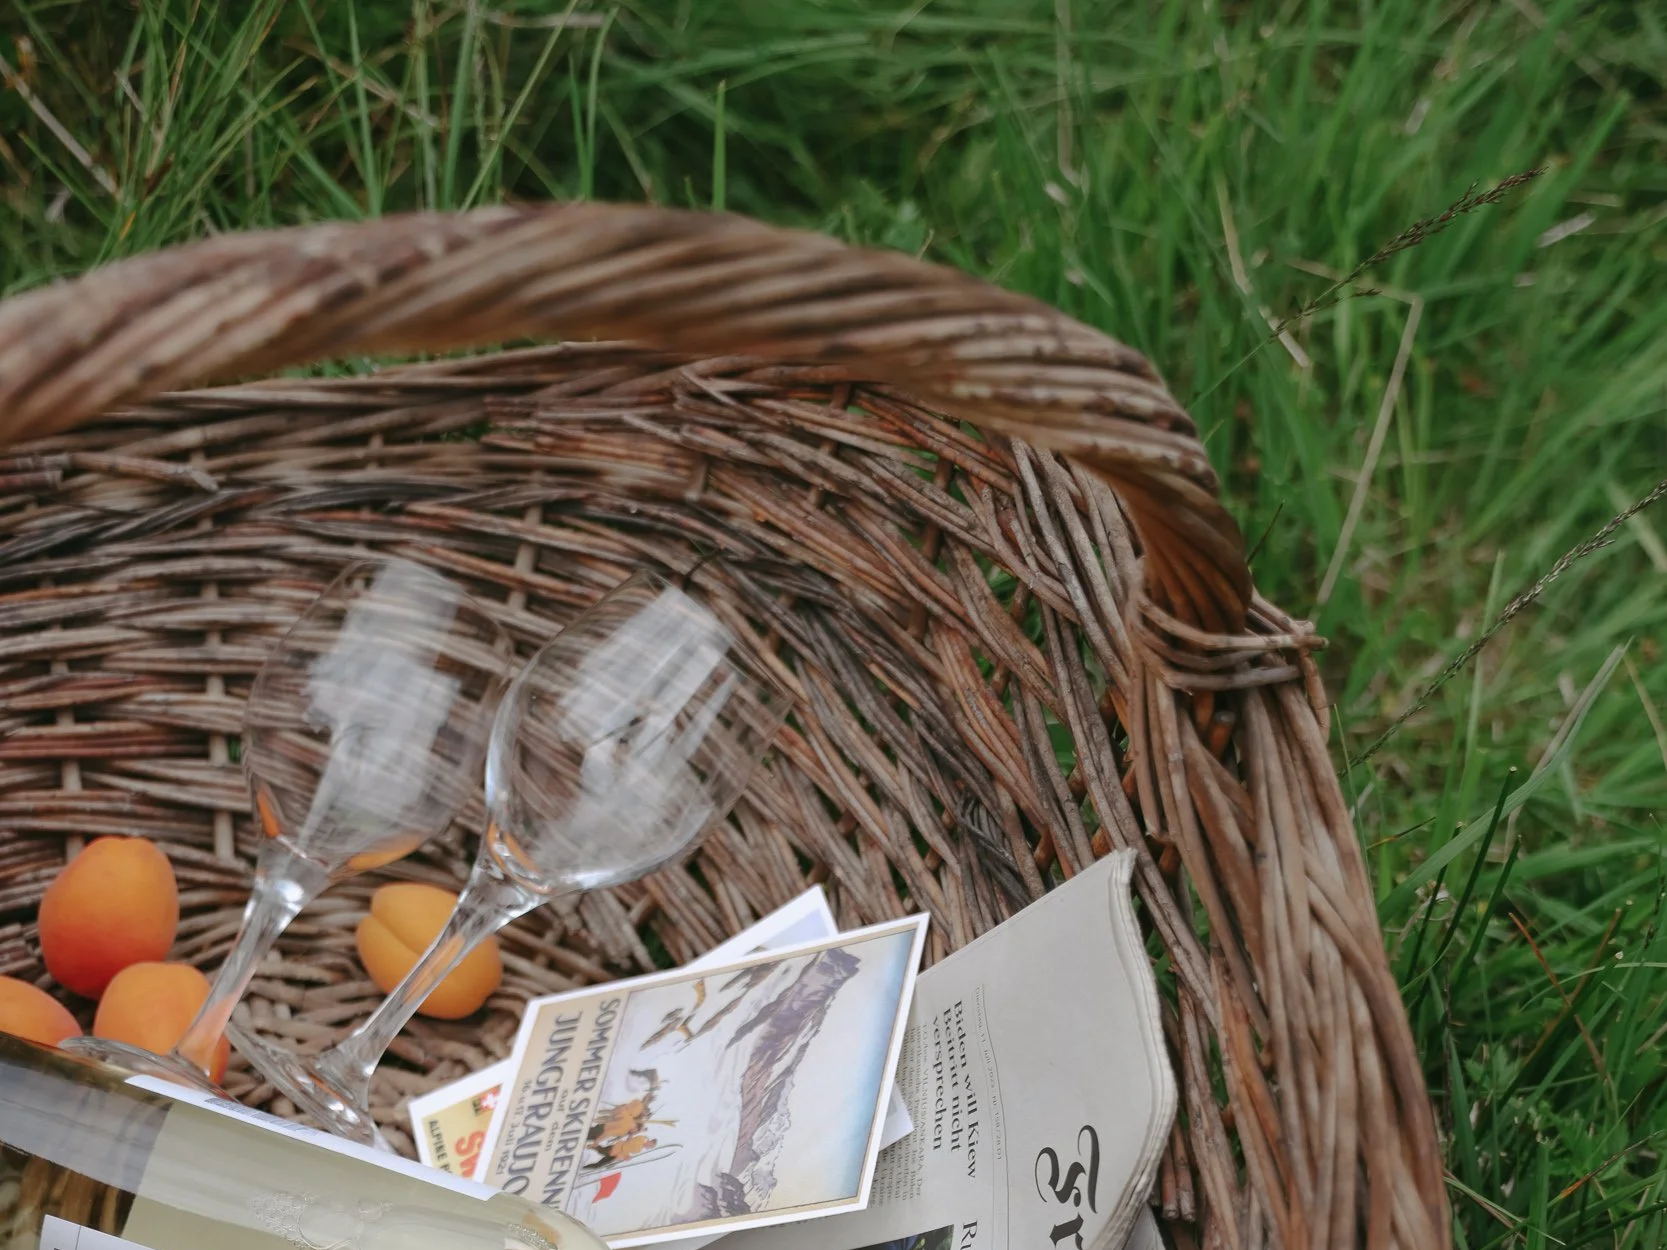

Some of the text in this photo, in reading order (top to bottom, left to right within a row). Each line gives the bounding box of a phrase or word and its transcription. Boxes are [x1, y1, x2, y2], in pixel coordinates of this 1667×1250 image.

[541, 997, 622, 1210] SOMMER SKIRENN
[544, 1121, 559, 1152] dem
[933, 1016, 947, 1150] versprechen
[943, 1008, 964, 1151] Beitritt nicht
[954, 1000, 979, 1178] Biden will Kiew
